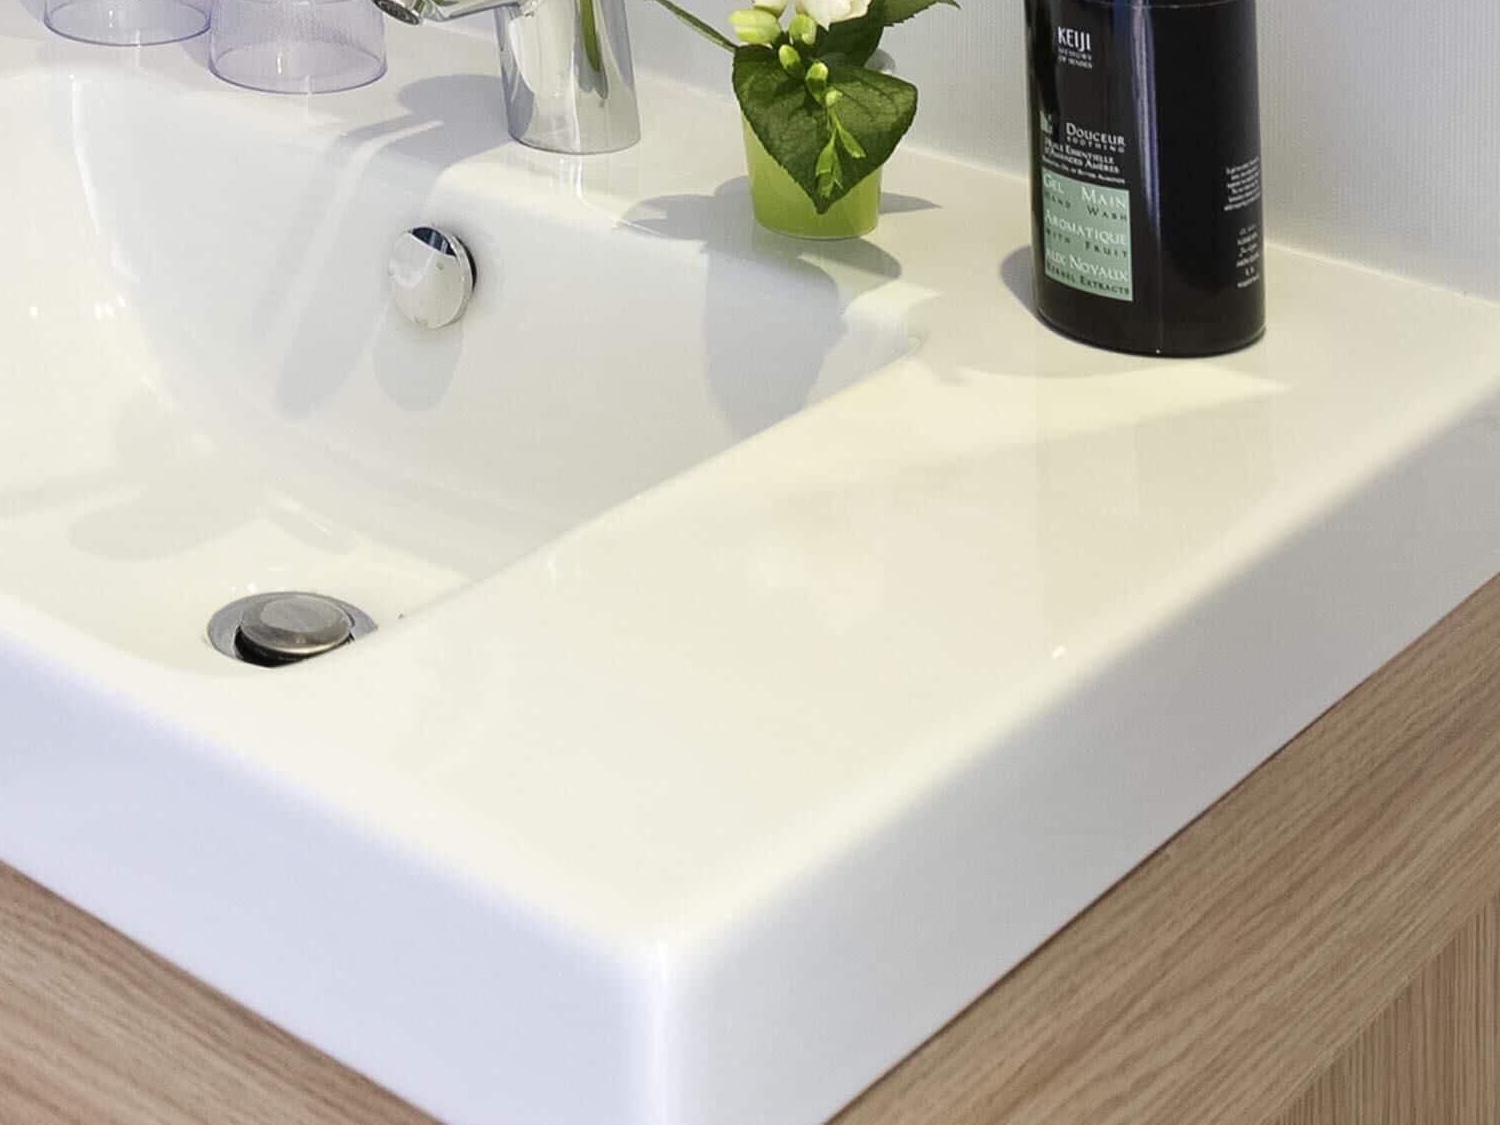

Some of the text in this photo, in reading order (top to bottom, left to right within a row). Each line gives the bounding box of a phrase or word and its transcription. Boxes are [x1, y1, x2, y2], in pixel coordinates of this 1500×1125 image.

[1058, 26, 1091, 52] KEIJI
[1066, 122, 1126, 146] DOUCEUR
[1081, 186, 1126, 209] MAIN
[1069, 254, 1129, 282] NOYAUX
